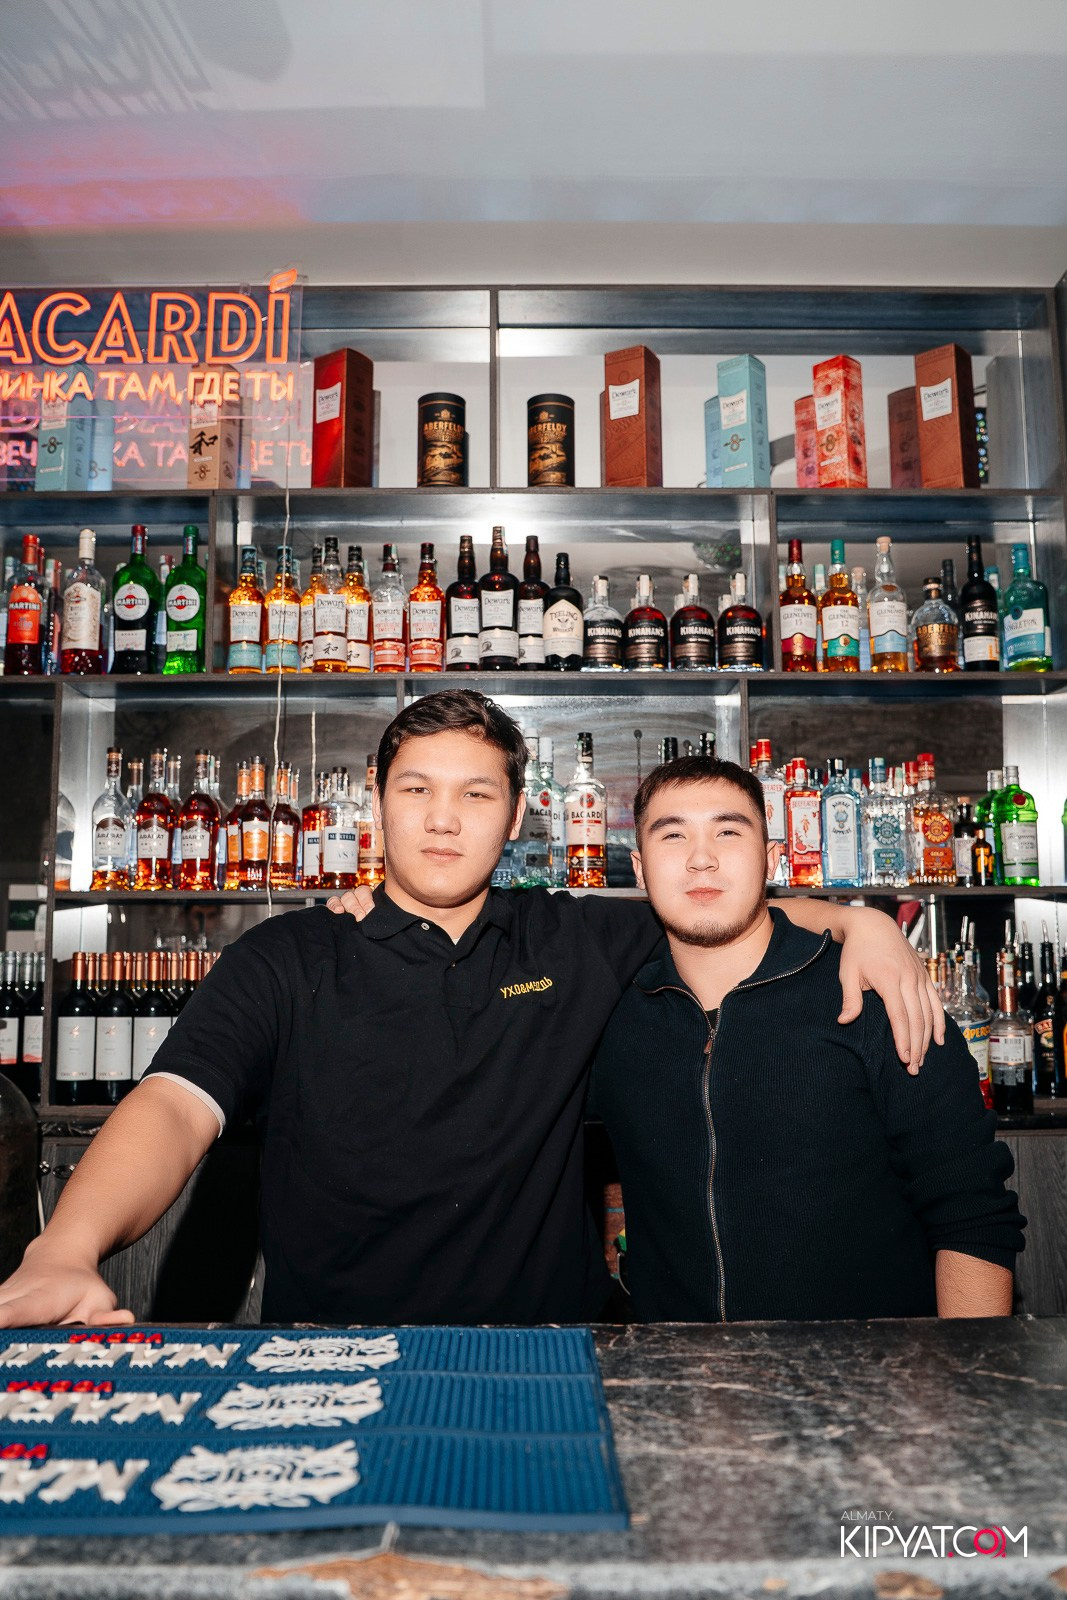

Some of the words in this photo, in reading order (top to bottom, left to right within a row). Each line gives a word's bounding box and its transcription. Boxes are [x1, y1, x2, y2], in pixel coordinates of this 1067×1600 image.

[0, 371, 95, 402] ИНКА
[186, 371, 241, 408] ГДЕ
[244, 371, 295, 402] ТЫ
[8, 601, 41, 611] MARTINI
[116, 598, 147, 606] MARTINI
[167, 599, 197, 608] MARTINI
[550, 611, 579, 621] TEELING
[962, 1025, 991, 1041] APERO
